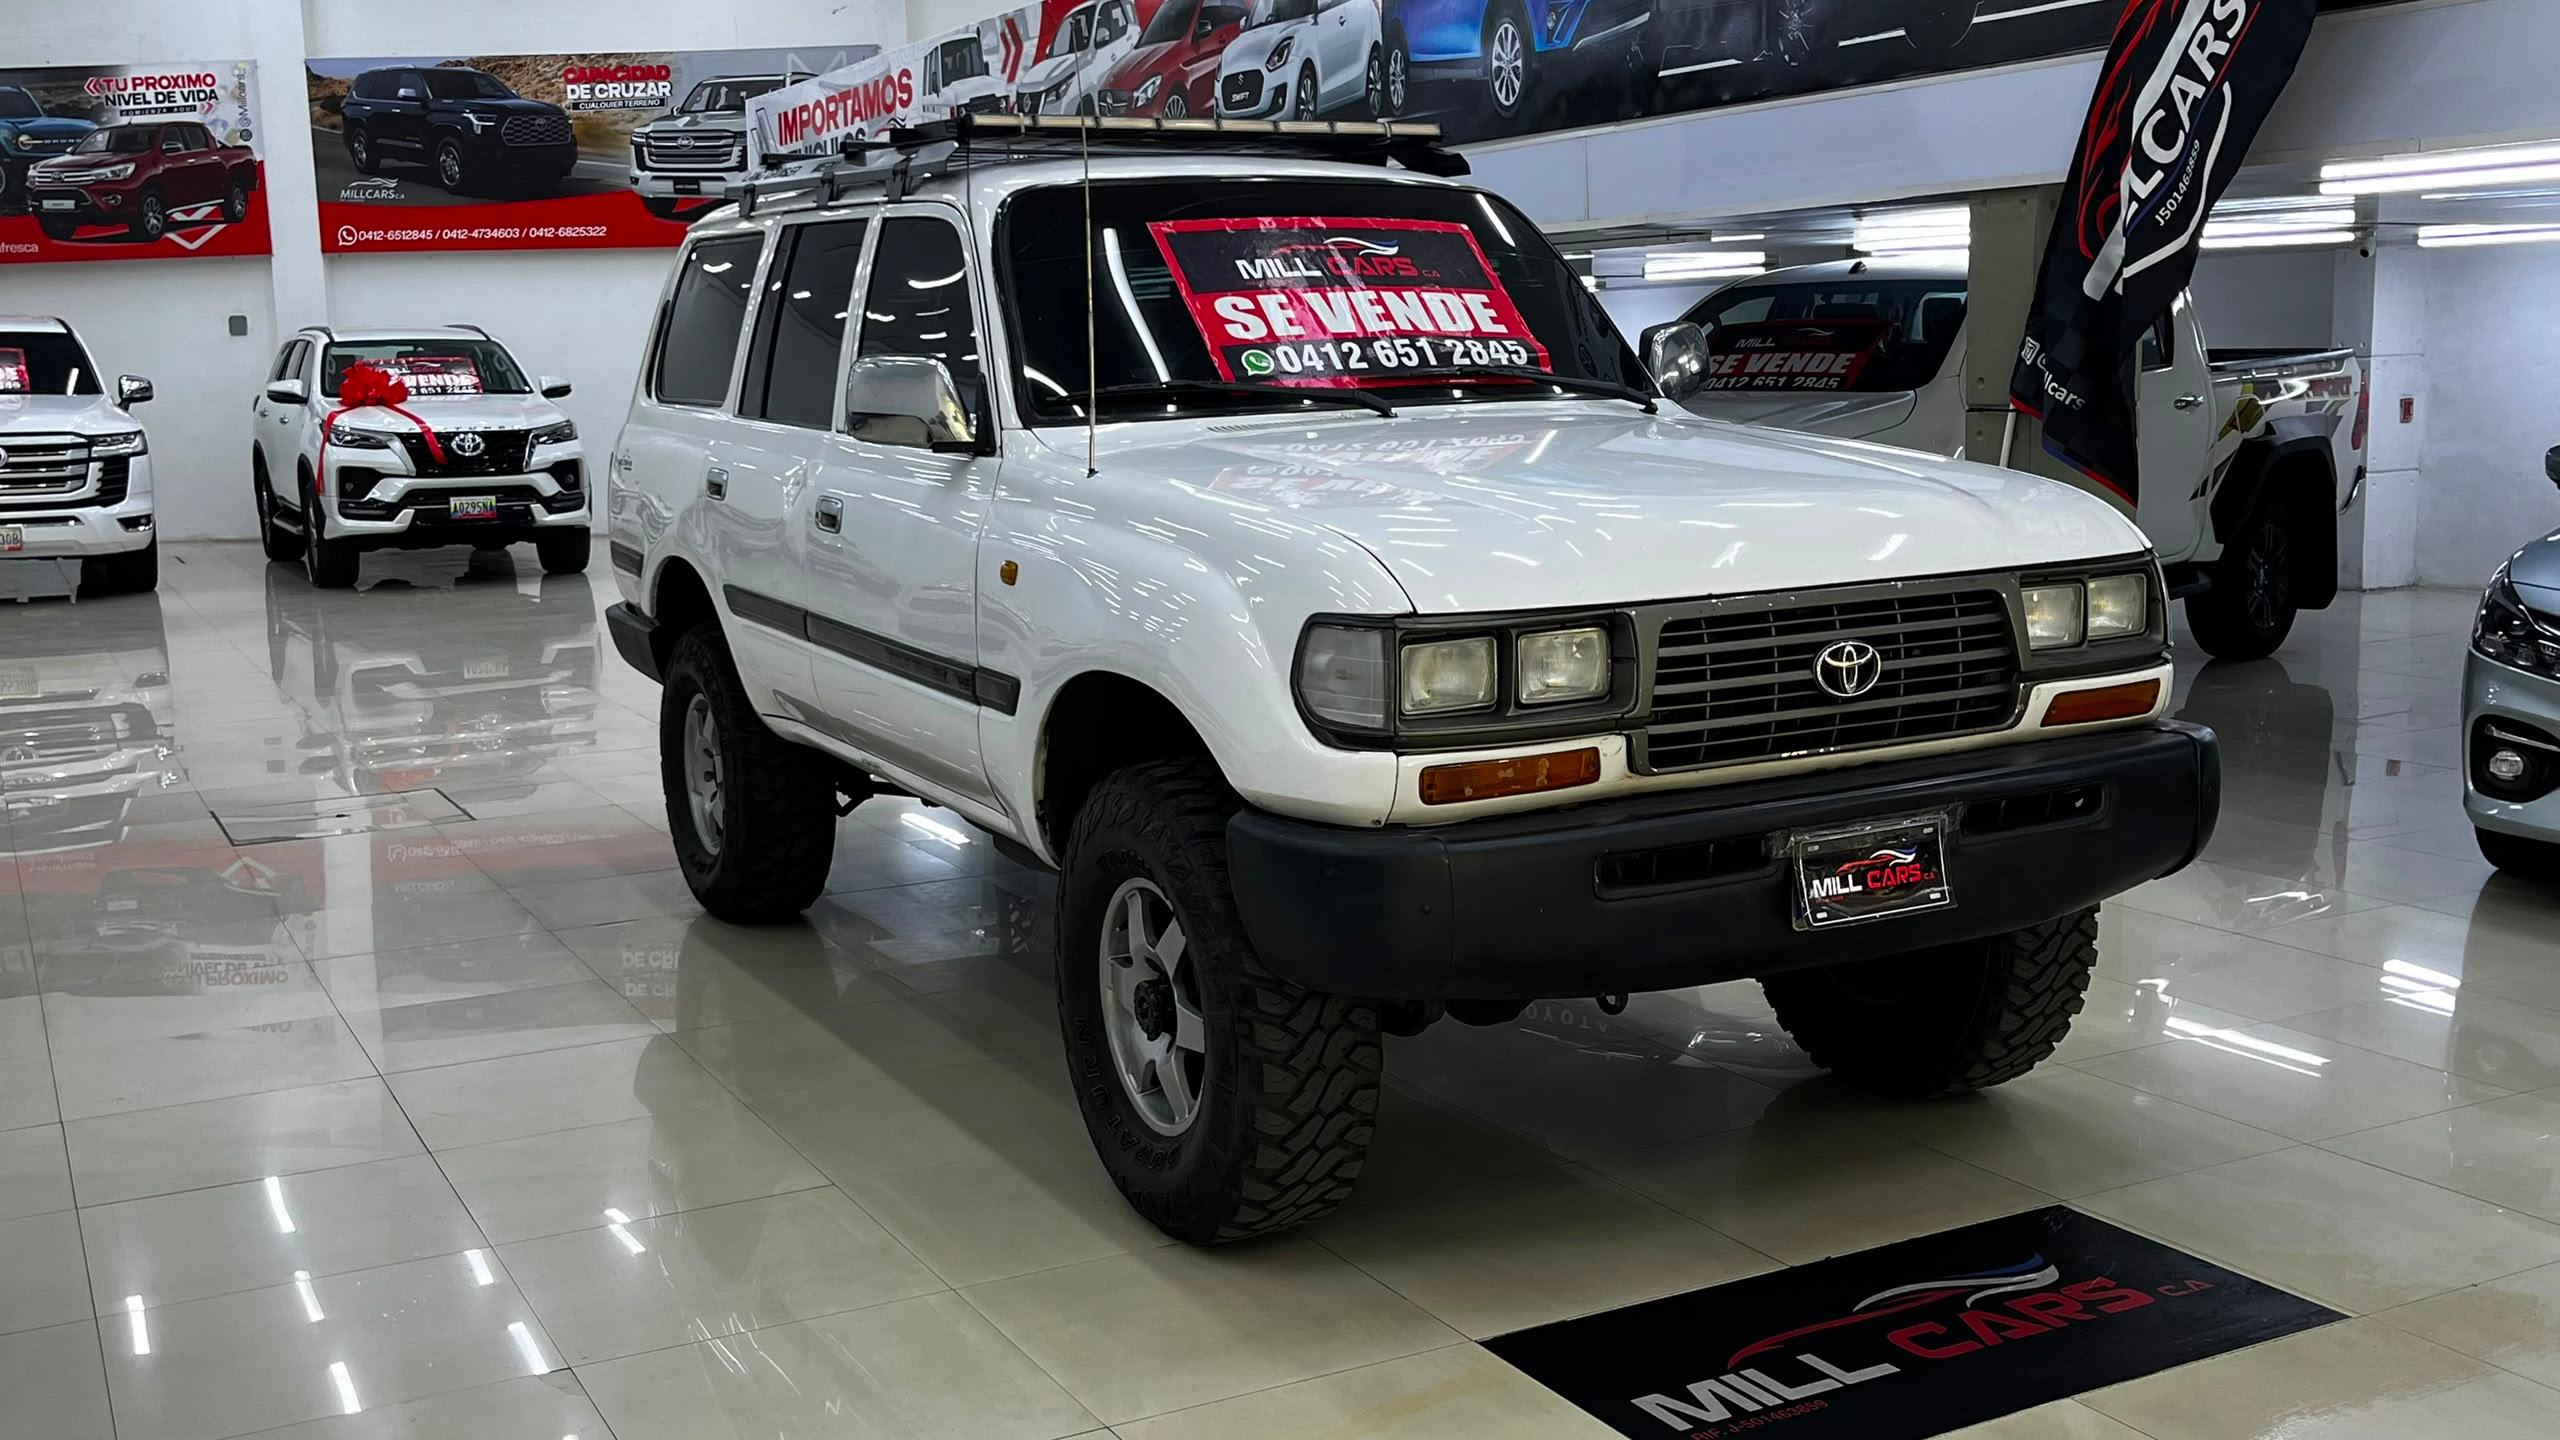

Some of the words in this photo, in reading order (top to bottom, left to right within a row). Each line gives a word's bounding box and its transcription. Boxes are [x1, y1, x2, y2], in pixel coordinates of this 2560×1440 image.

[102, 77, 128, 92] TU
[131, 73, 217, 91] PROXIMO
[563, 65, 671, 84] CAPACIDAD
[105, 92, 152, 106] NIVEL
[155, 91, 178, 104] DE
[180, 89, 218, 102] VIDA
[566, 84, 591, 99] DE
[594, 82, 672, 98] CRUZAR
[1231, 91, 1250, 102] SWIFT
[121, 108, 168, 116] COMIENZA
[579, 100, 623, 109] CUALQUIER
[624, 99, 660, 107] TERRENO
[777, 68, 914, 147] IMPORTAMOS
[2154, 139, 2200, 226] J501463859
[340, 189, 395, 199] MILLCARS
[358, 229, 433, 241] 0412-6512845
[442, 227, 519, 239] 0412-4734603
[529, 226, 607, 237] 0412-6825322
[0, 242, 39, 253] fresca
[1234, 257, 1322, 280] MILL
[1327, 256, 1419, 278] CARS
[1213, 293, 1305, 340] SE
[1311, 291, 1509, 336] VENDE
[1735, 338, 1776, 348] MILL
[1277, 341, 1368, 374] 0412
[1378, 339, 1438, 369] 651
[1450, 337, 1529, 367] 2845
[1709, 354, 1743, 374] SE
[1744, 353, 1856, 374] VENDE
[1752, 376, 1788, 388] 651
[1791, 377, 1840, 389] 2845
[1812, 874, 1863, 898] MILL
[1867, 863, 1922, 889] CARS
[1630, 1353, 1900, 1432] MILL
[1887, 1276, 2155, 1359] CARS
[1729, 1400, 1829, 1434] J-501463859
